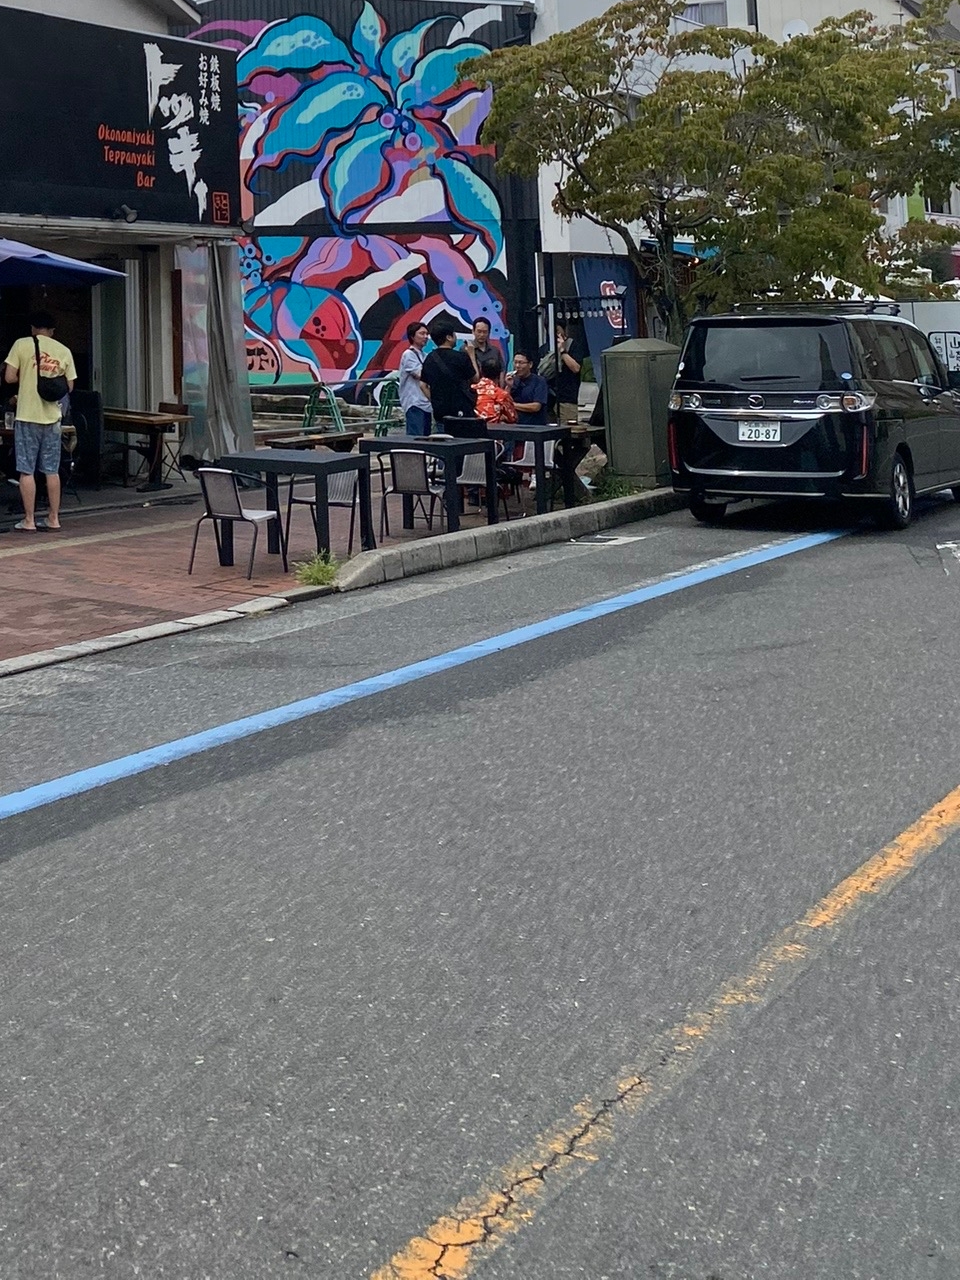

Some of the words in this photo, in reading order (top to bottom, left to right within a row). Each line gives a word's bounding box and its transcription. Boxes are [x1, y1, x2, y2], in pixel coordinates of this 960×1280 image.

[197, 52, 210, 126] お好み焼
[209, 54, 222, 112] 鉄板焼
[97, 123, 155, 146] Okonomiyaki
[143, 42, 208, 222] トッキー
[103, 145, 156, 167] Teppanyaki
[136, 170, 156, 188] Bar
[747, 428, 778, 440] 20-87
